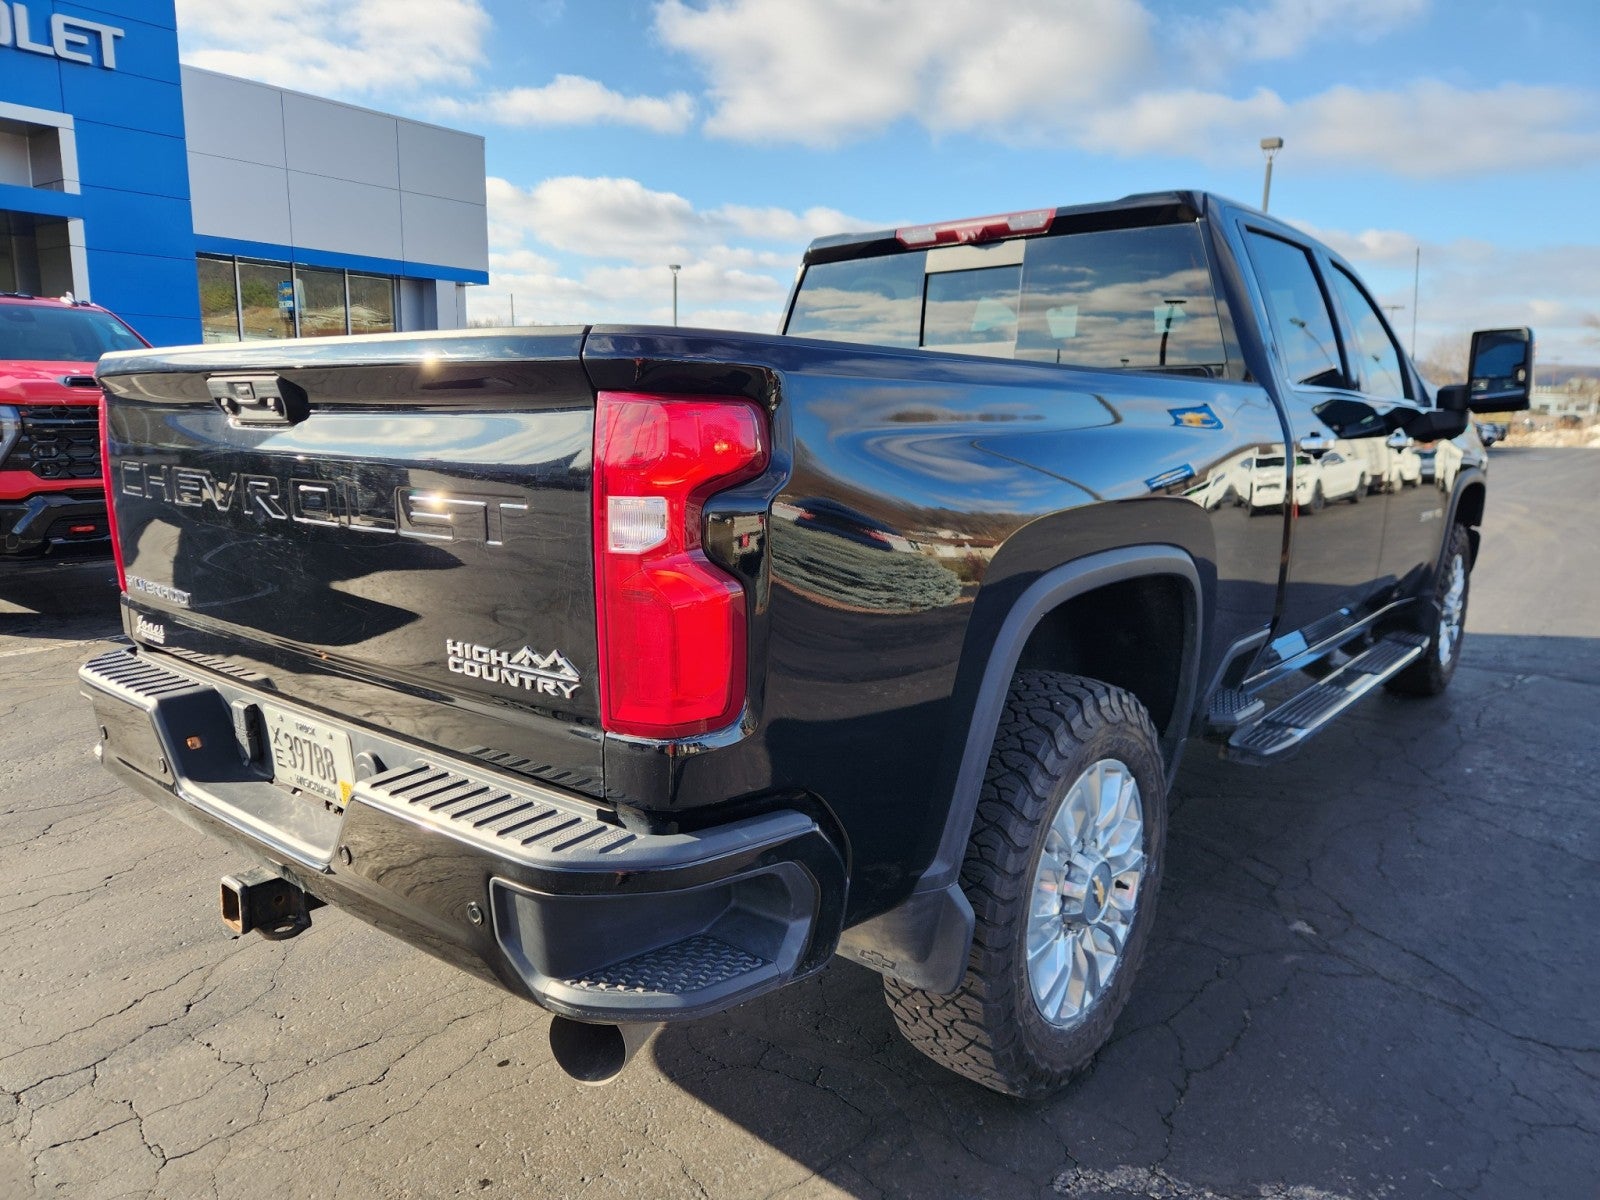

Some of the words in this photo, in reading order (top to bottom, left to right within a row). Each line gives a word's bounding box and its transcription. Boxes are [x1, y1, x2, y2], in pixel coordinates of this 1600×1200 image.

[119, 460, 528, 546] CHEVROLET
[446, 638, 509, 667] HIGH
[448, 656, 582, 699] COUNTRY
[284, 733, 337, 785] 39788
